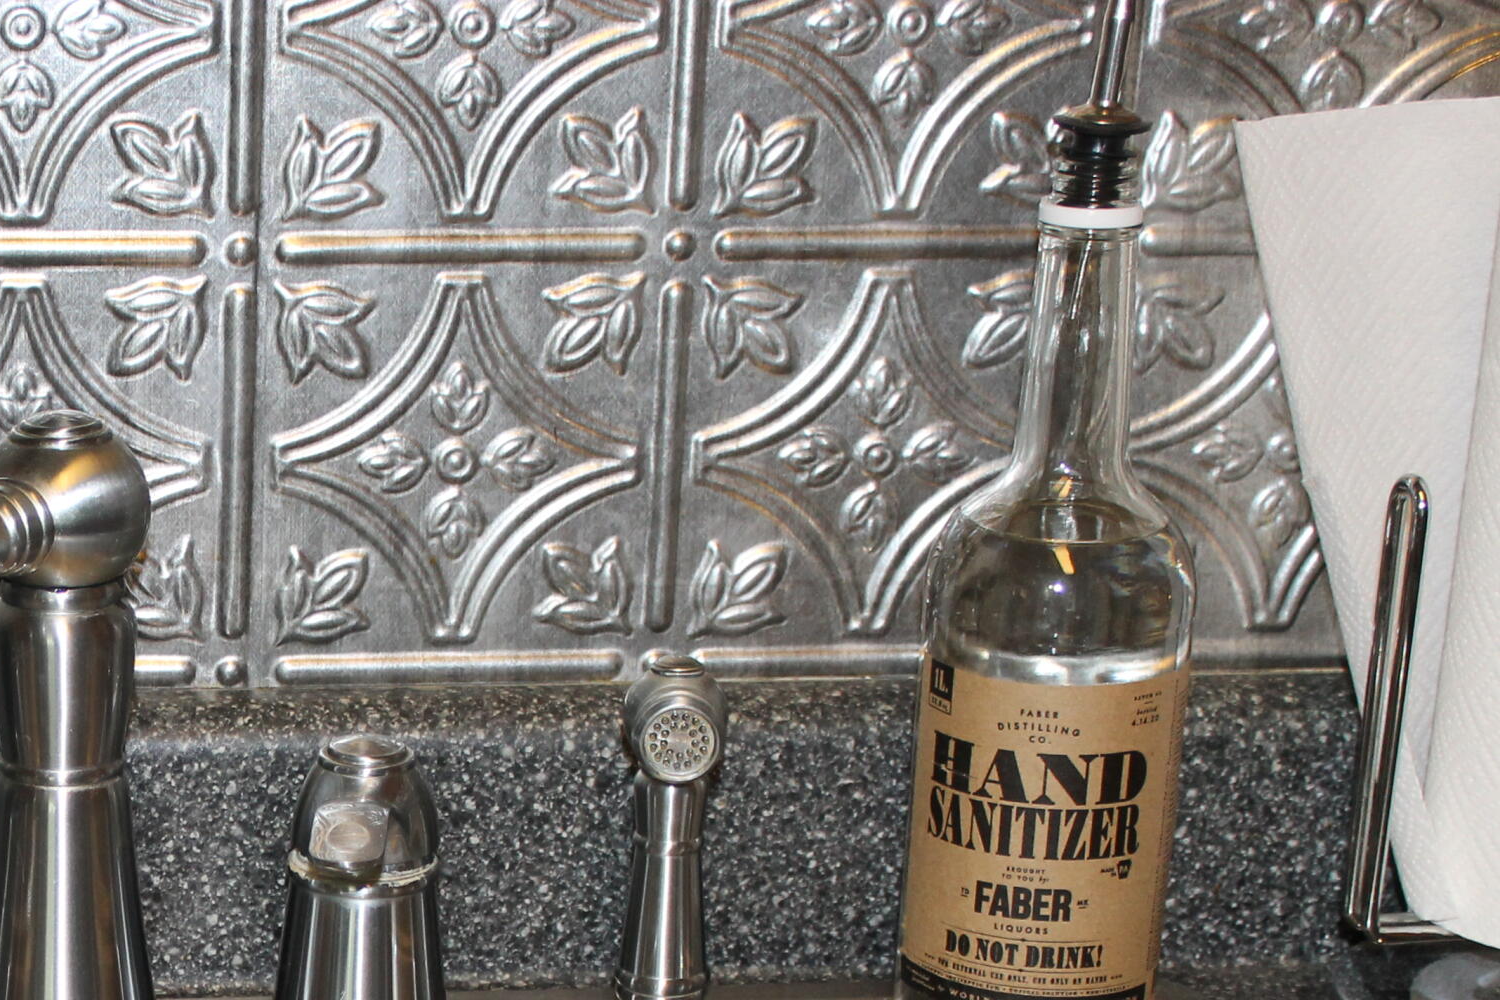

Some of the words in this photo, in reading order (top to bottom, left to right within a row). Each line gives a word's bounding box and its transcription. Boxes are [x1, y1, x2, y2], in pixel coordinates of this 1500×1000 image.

[1020, 708, 1060, 719] FABER
[997, 722, 1081, 737] DISTILLING
[931, 730, 1148, 806] HAND
[927, 785, 1140, 861] SANITIZER
[1006, 866, 1046, 876] BROUGHT
[1002, 873, 1012, 881] TO
[1017, 875, 1035, 883] YOU
[974, 880, 1072, 922] FABER
[994, 923, 1049, 935] LIQUORS
[945, 929, 971, 957] DO
[975, 937, 1019, 966] NOT
[1025, 944, 1104, 969] DRINK!
[1050, 977, 1068, 985] ONLY
